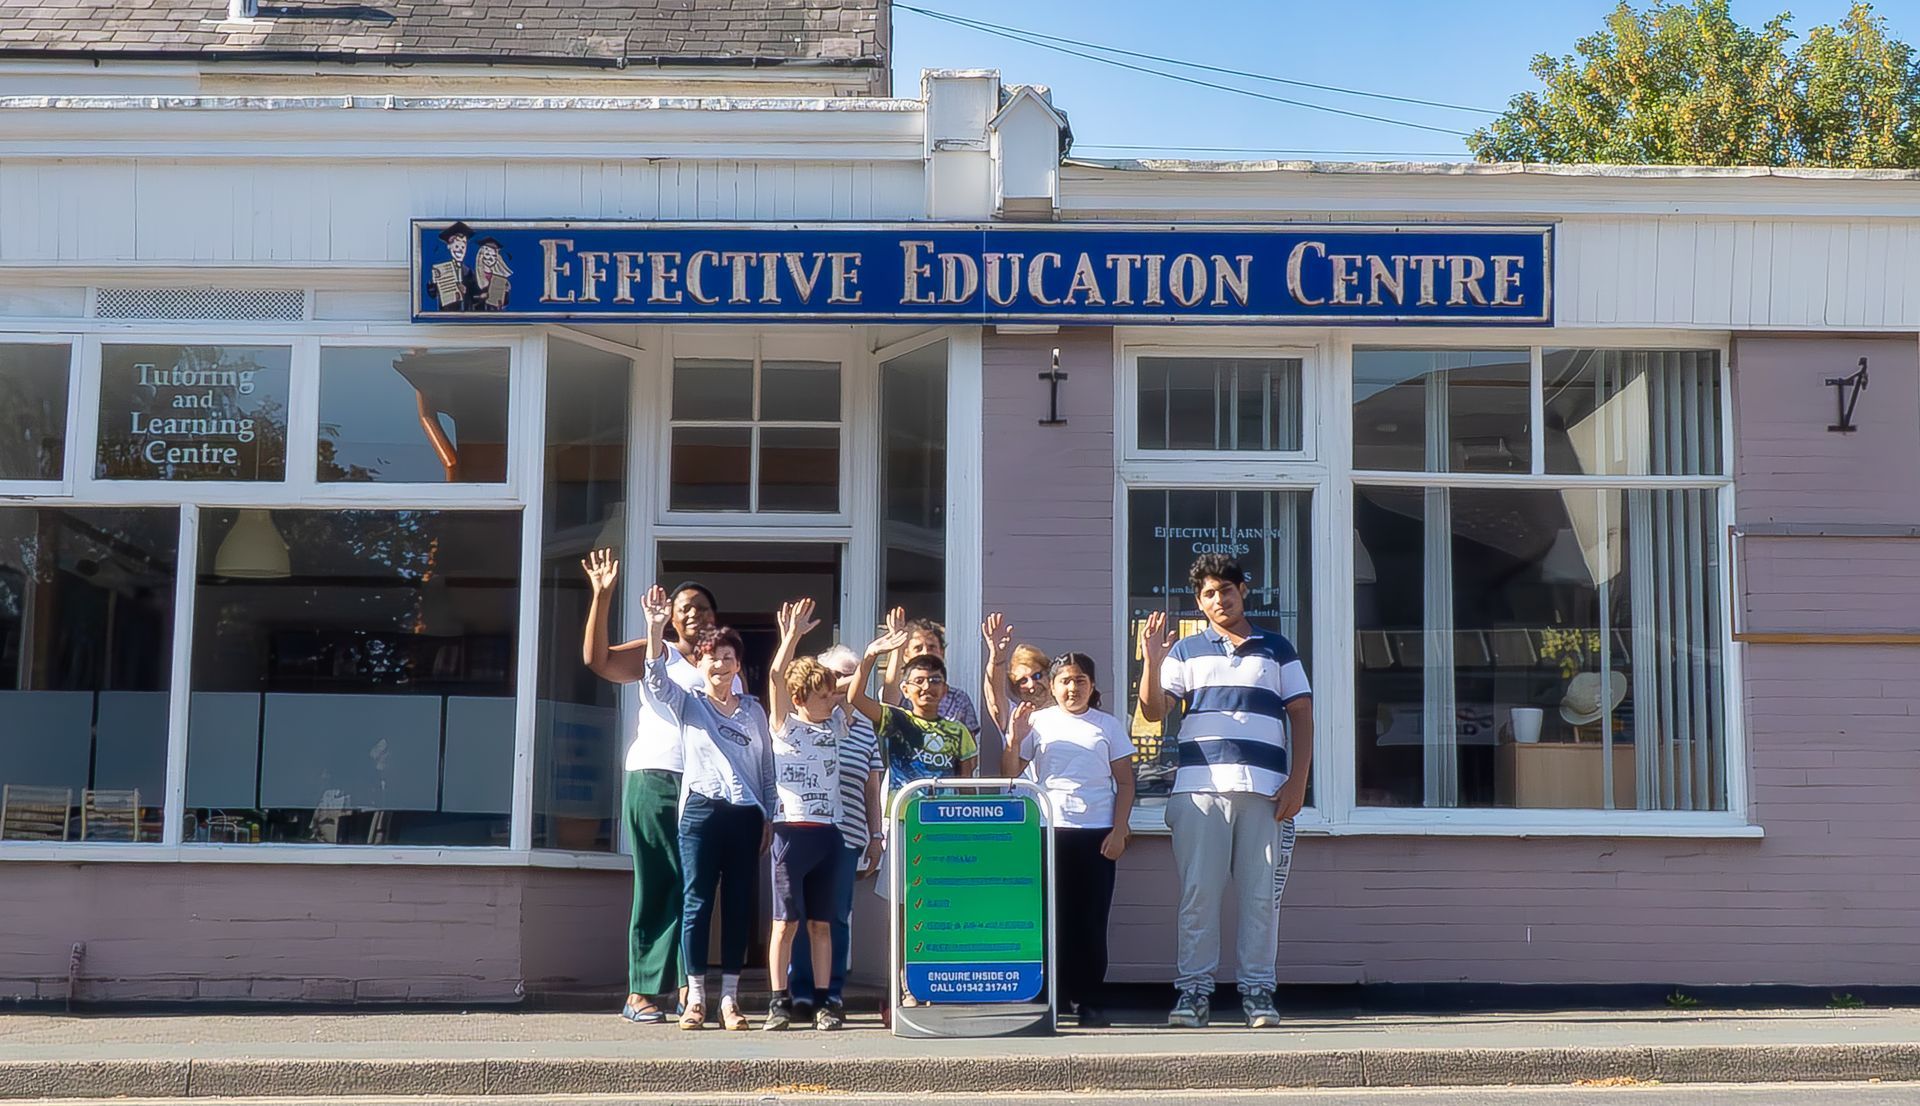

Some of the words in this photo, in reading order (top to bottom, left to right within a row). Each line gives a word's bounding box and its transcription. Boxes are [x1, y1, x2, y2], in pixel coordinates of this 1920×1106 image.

[539, 238, 863, 305] EFFECTIVE
[899, 240, 1253, 306] EDUCATION
[1286, 241, 1525, 307] CENTRE
[134, 363, 255, 394] Tutoring
[172, 390, 214, 408] and
[130, 411, 256, 443] Learning
[145, 440, 238, 464] Centre
[1191, 541, 1250, 554] COURSES
[912, 748, 954, 768] XBOX
[938, 806, 1004, 818] TUTORING
[928, 971, 970, 981] ENQUIRE
[972, 971, 1004, 981] INSIDE
[1005, 971, 1020, 980] OR
[930, 983, 955, 992] CALL
